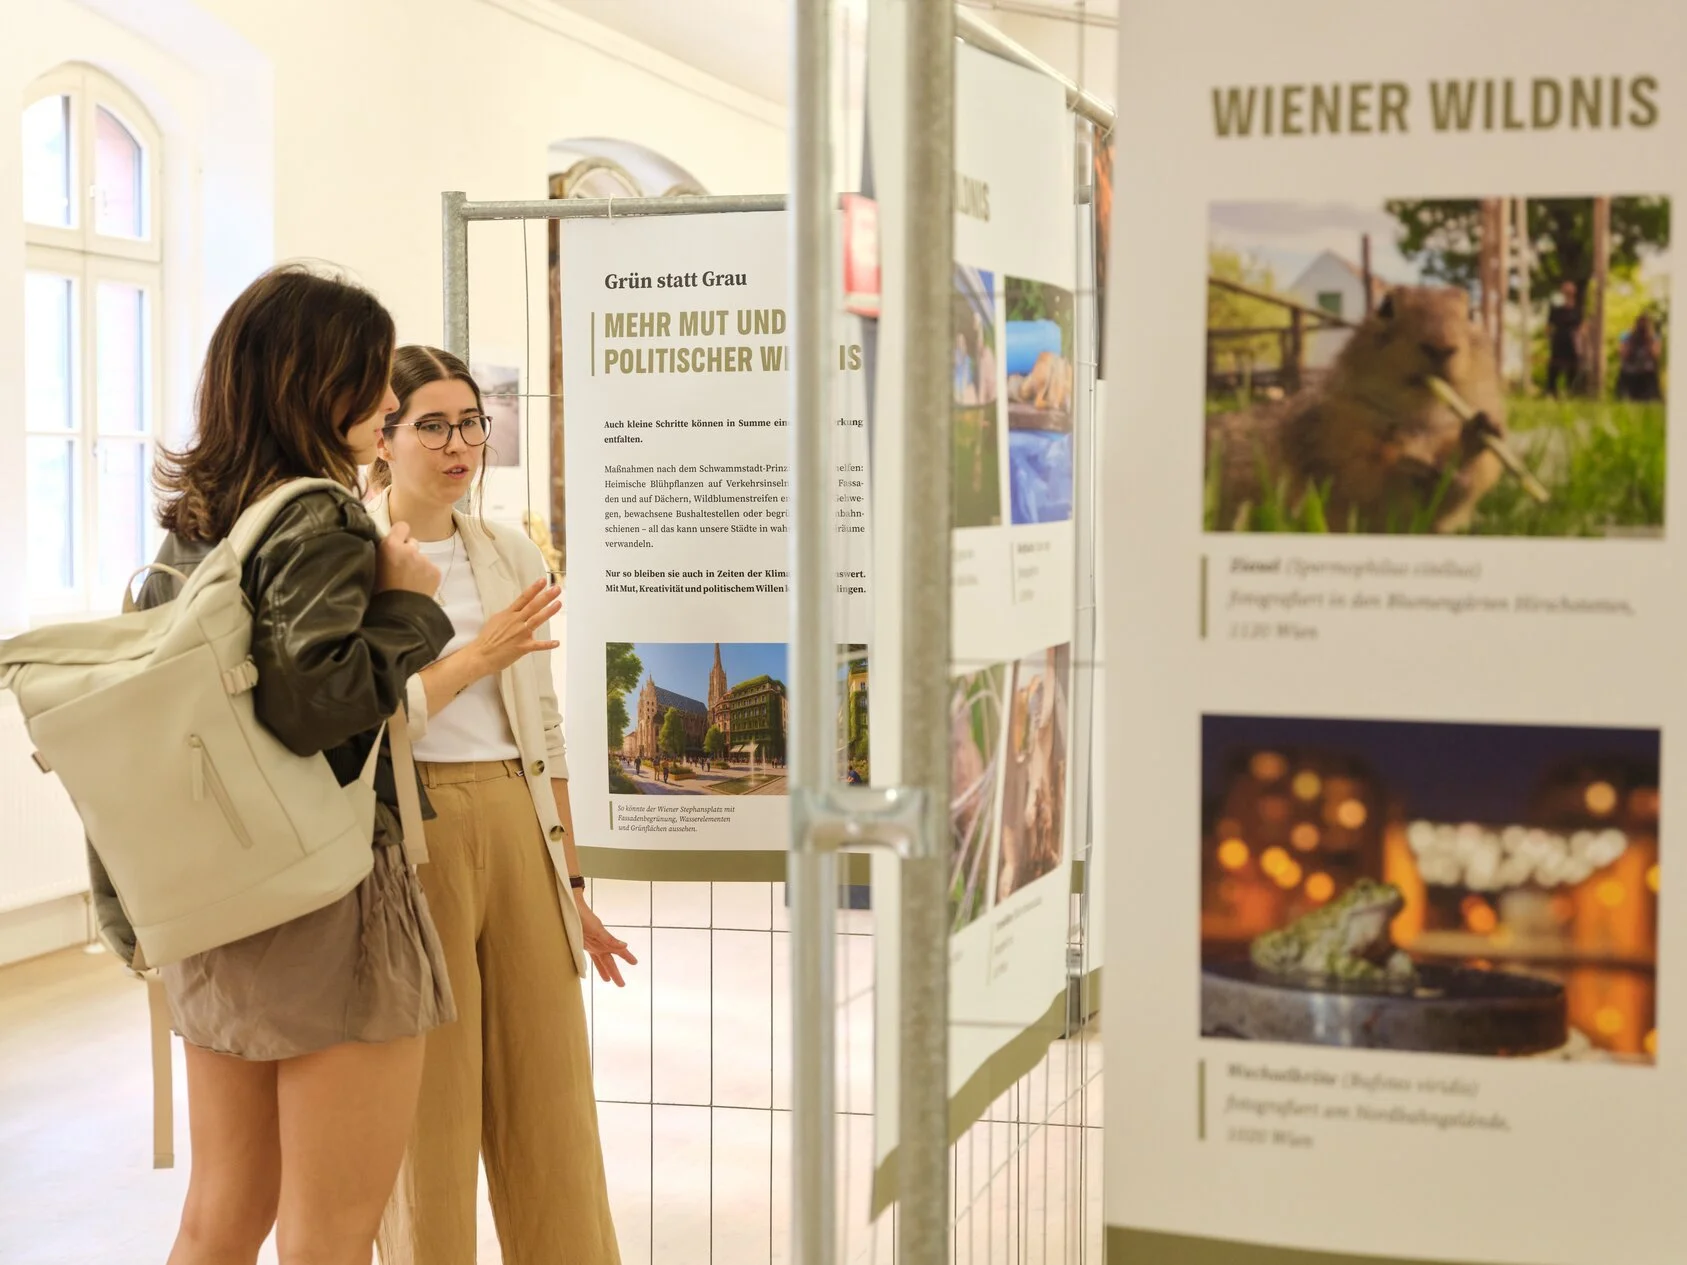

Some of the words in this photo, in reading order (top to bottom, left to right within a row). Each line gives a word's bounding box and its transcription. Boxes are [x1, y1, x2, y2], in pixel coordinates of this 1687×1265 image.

[1212, 80, 1411, 137] WIENER
[1429, 74, 1660, 133] WILDNIS
[605, 273, 652, 289] Grün
[657, 273, 697, 288] statt
[702, 271, 747, 286] Grau
[605, 312, 671, 338] MEHR
[680, 310, 729, 336] MUT
[738, 309, 786, 335] UND
[605, 345, 753, 374] POLITISCHER
[605, 420, 624, 428] Auch
[627, 419, 653, 428] kleine
[656, 419, 688, 428] Schritte
[691, 419, 723, 428] können
[727, 419, 735, 427] in
[739, 418, 771, 427] Summe
[774, 418, 791, 427] ein
[834, 418, 863, 429] rkung
[605, 435, 642, 443] entfalten.
[605, 465, 654, 473] Maßnahmen
[657, 464, 676, 473] nach
[679, 464, 697, 473] dem
[699, 464, 791, 473] Schwammstadt-Prinz
[605, 480, 646, 488] Heimische
[650, 479, 704, 491] Blühpflanzen
[708, 479, 722, 488] auf
[605, 495, 619, 503] den
[622, 495, 637, 503] und
[639, 495, 652, 503] auf
[654, 494, 691, 506] Dächern,
[694, 494, 778, 503] Wildblumenstreifen
[605, 512, 621, 521] gen,
[624, 510, 672, 518] bewachsene
[676, 509, 740, 518] Bushaltestellen
[743, 509, 762, 518] oder
[605, 525, 639, 533] schienen
[649, 525, 658, 533] all
[661, 525, 674, 533] das
[677, 525, 697, 533] kann
[731, 524, 757, 533] Städte
[759, 524, 767, 533] in
[605, 540, 653, 548] verwandeln.
[606, 569, 620, 578] Nur
[635, 569, 665, 578] bleiben
[668, 569, 680, 578] sie
[683, 569, 703, 578] auch
[706, 569, 714, 578] in
[717, 569, 744, 578] Zeiten
[747, 569, 762, 578] der
[606, 584, 619, 593] Mit
[620, 584, 638, 595] Mut,
[639, 584, 684, 593] Kreativität
[685, 584, 702, 593] und
[703, 584, 755, 596] politischem
[756, 584, 784, 593] Willen
[680, 806, 722, 814] Stephansplatz
[618, 815, 677, 823] Fassadenbegrünung,
